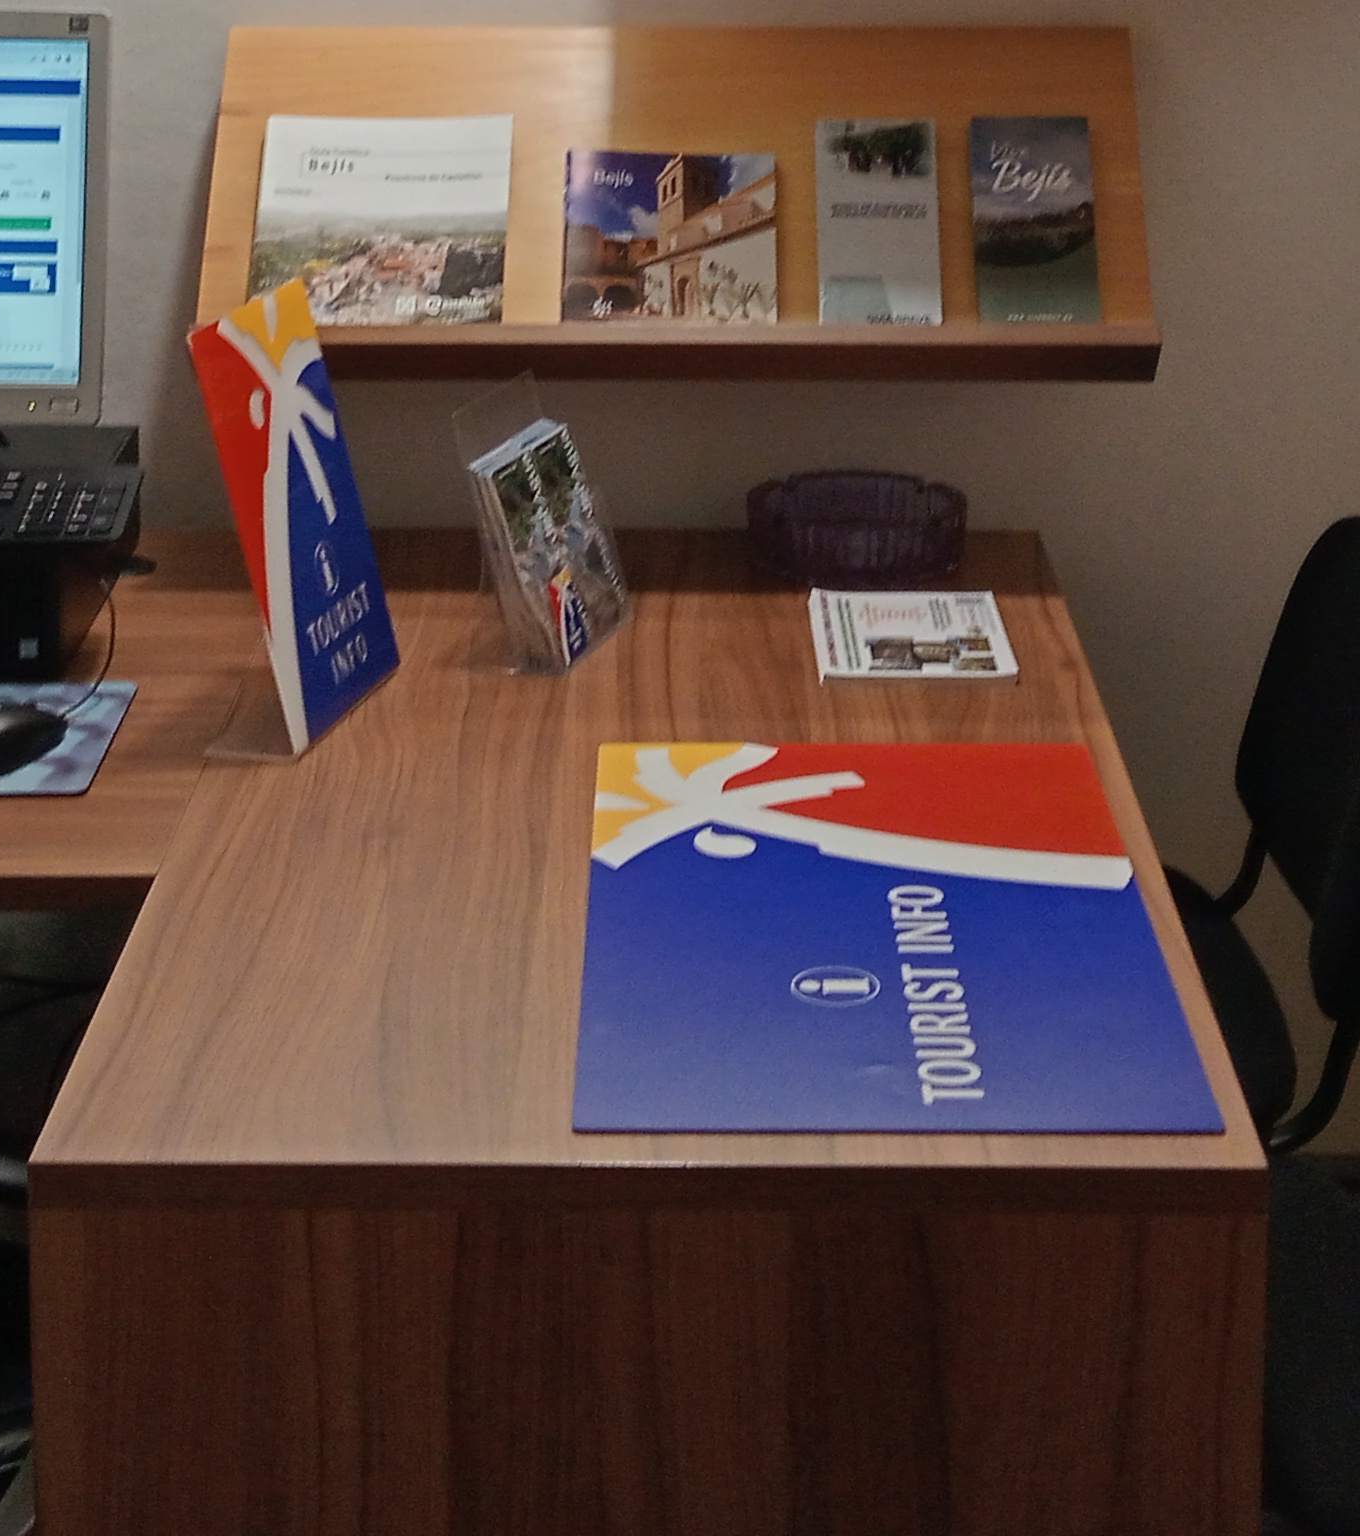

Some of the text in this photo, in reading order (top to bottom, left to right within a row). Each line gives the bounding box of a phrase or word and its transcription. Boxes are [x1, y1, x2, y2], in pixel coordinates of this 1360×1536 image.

[306, 580, 370, 657] TOURIST
[331, 633, 368, 687] INFO
[887, 884, 985, 1106] TOURIST INFO
